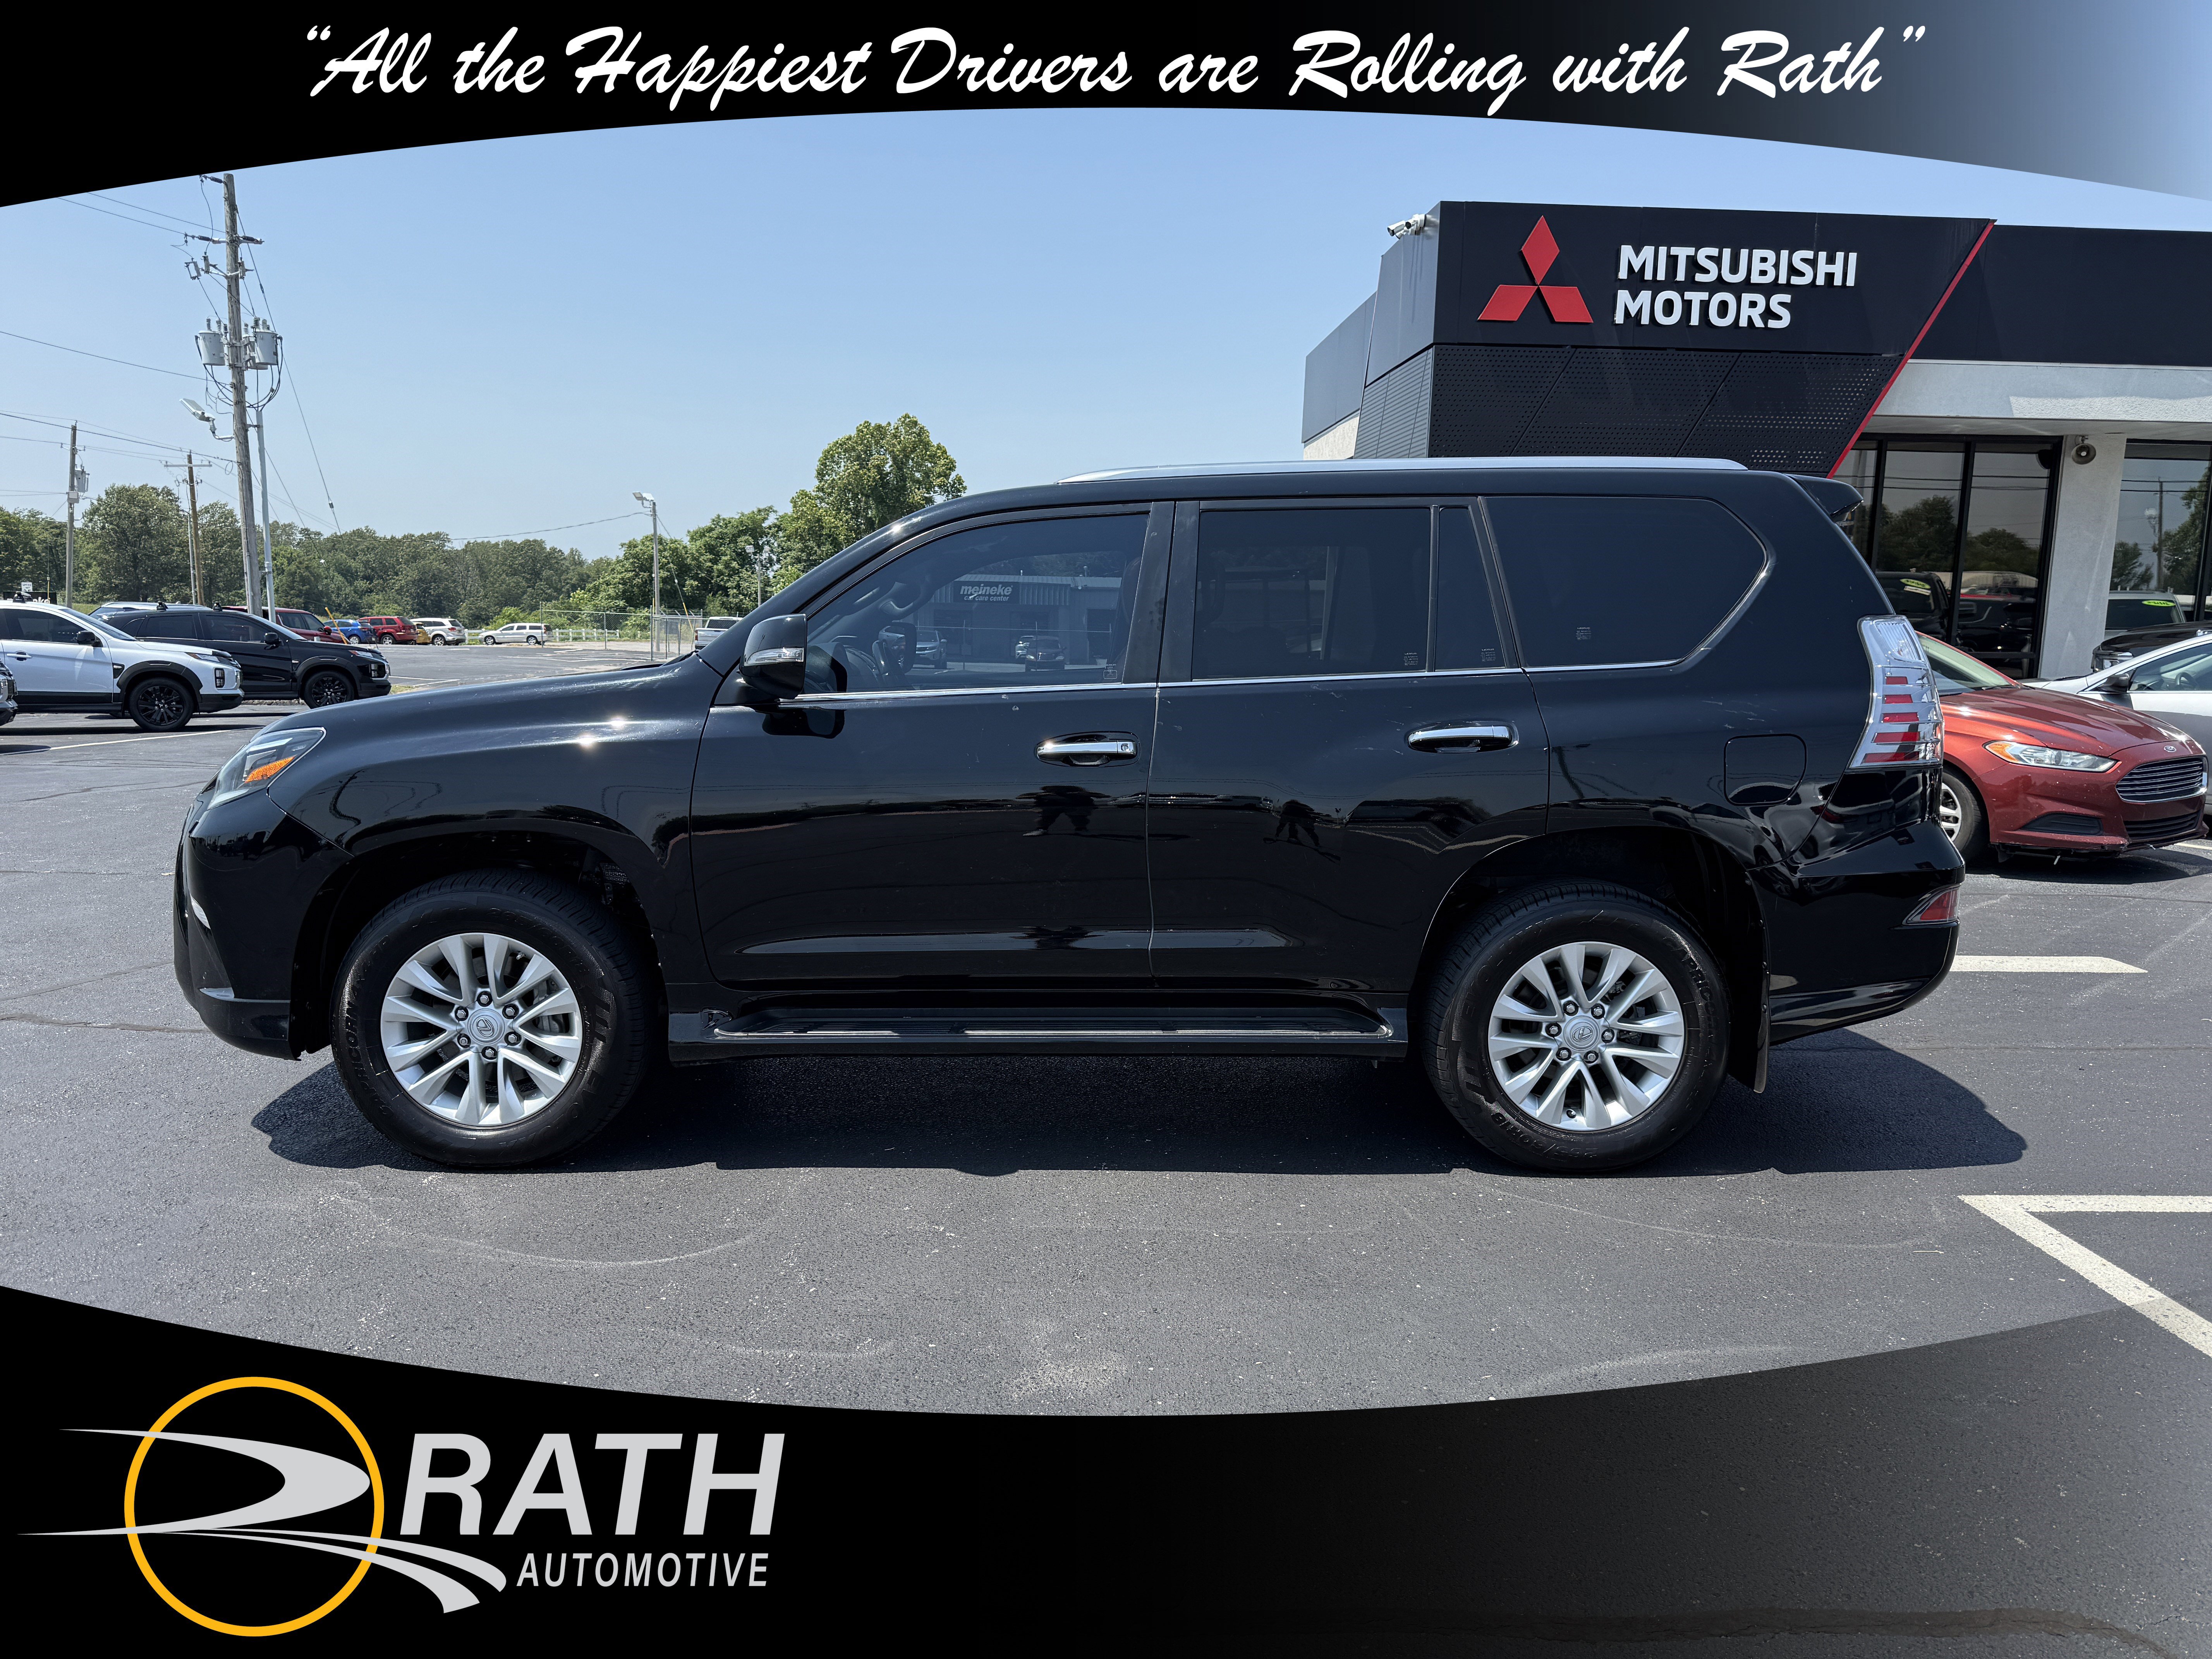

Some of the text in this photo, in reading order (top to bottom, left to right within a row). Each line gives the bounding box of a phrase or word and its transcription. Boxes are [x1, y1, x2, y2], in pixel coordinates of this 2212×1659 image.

[1617, 245, 1857, 286] MITSUBISHI
[1613, 290, 1791, 328] MOTORS
[960, 584, 1012, 595] meineke
